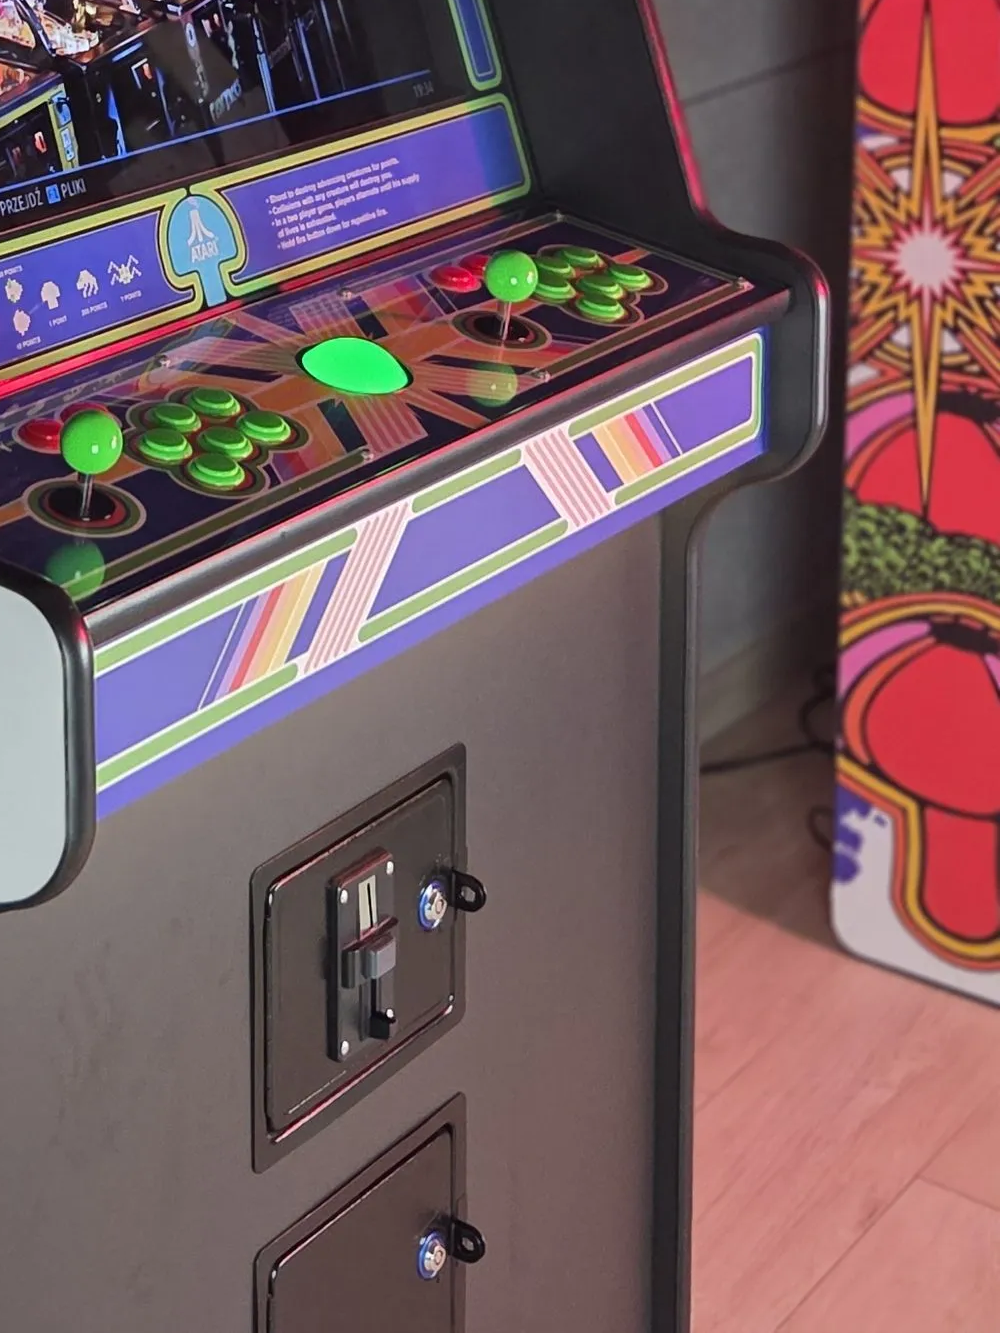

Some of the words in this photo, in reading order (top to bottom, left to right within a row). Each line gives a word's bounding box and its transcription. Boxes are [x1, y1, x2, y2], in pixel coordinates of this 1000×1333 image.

[0, 188, 44, 216] PRZEJDŹ
[60, 178, 87, 199] PLIKI
[191, 241, 219, 263] ATARI
